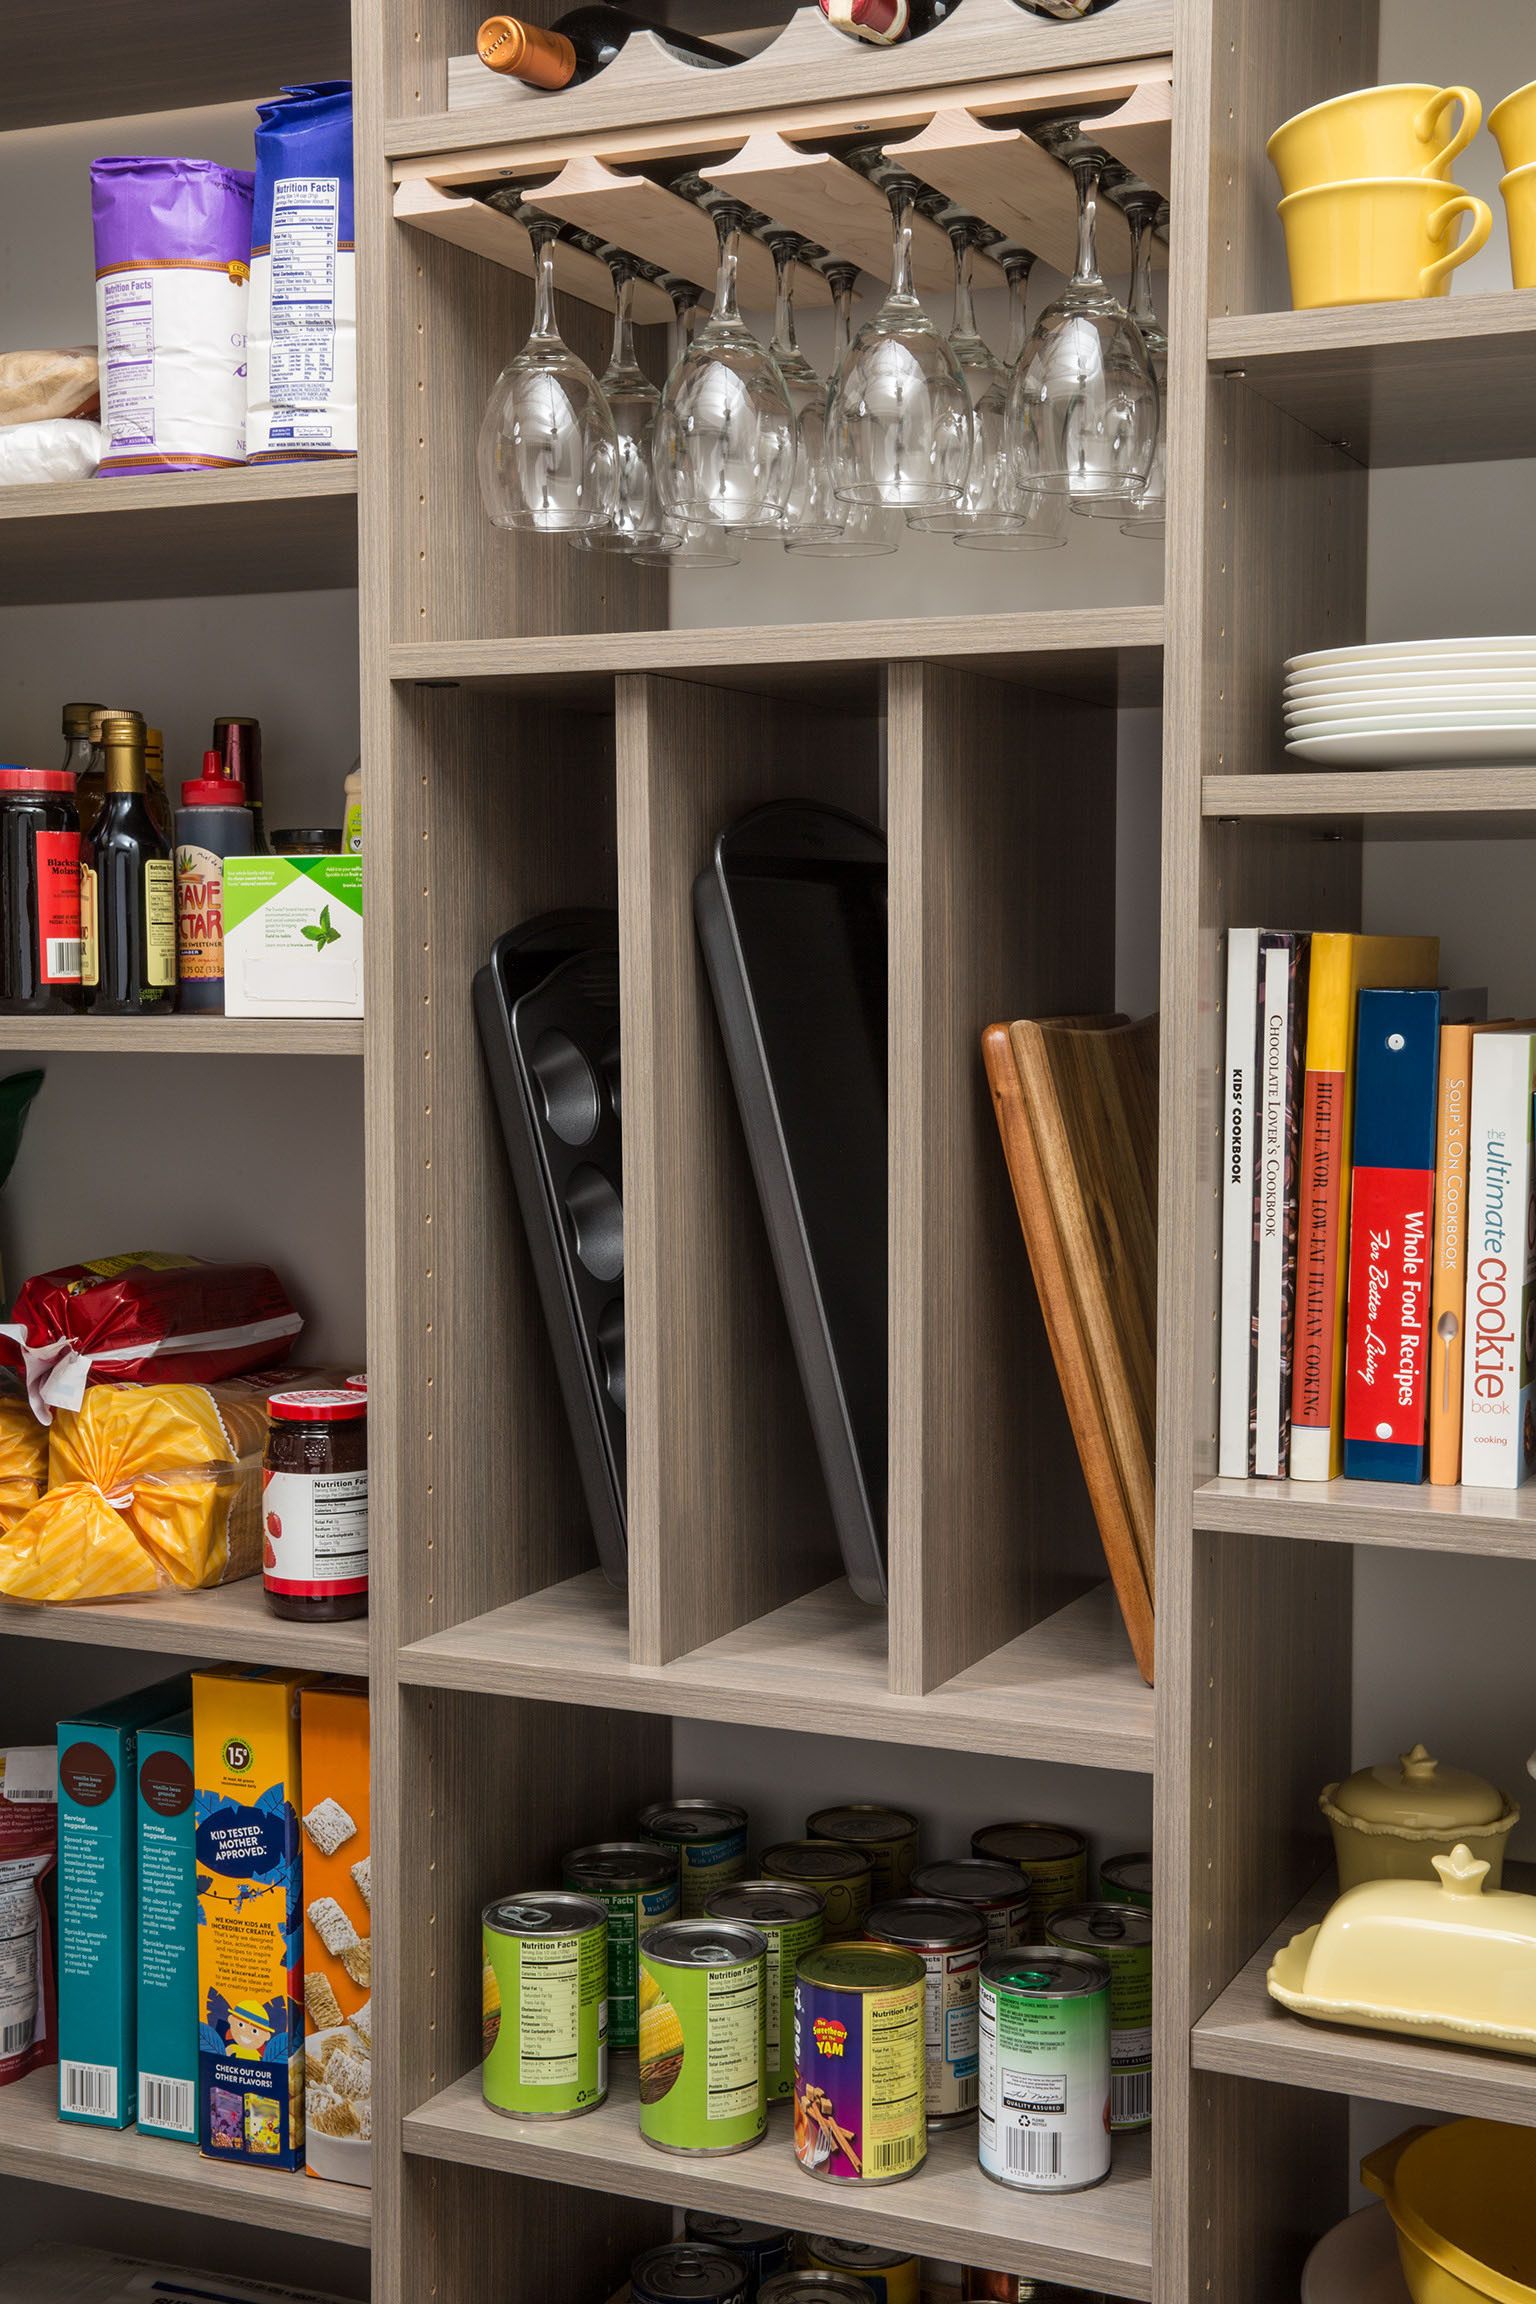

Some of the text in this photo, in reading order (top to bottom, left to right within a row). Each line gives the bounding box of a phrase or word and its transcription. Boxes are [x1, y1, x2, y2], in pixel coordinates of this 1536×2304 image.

[276, 183, 335, 194] Nutrition Facts
[106, 281, 152, 295] Nutrition Facts
[178, 881, 221, 910] GAVE
[179, 910, 223, 939] CTAR
[195, 965, 204, 973] OZ
[1231, 1068, 1242, 1184] KIDS' COOKBOOK
[1265, 1014, 1283, 1238] CHOCOLATE LOVER'S COOKBOOK
[1487, 1128, 1506, 1140] the
[1445, 1079, 1465, 1270] SOUP'S ON COOKBOOK
[1484, 1141, 1512, 1254] ultimate
[1309, 1199, 1327, 1265] LOW-FAT
[1306, 1271, 1324, 1338] ITALIAN
[1357, 1229, 1390, 1386] For Better Living
[1393, 1211, 1425, 1406] Whole Food Recipes
[1474, 1257, 1515, 1399] cookie
[1303, 1343, 1321, 1416] COOKING
[1471, 1399, 1510, 1415] book
[1474, 1434, 1508, 1446] cooking
[314, 1480, 352, 1488] Nutrition
[64, 1814, 85, 1823] Serving
[64, 1822, 98, 1831] suggestions
[143, 1823, 164, 1833] Serving
[210, 1826, 263, 1840] KID TESTED.
[64, 1836, 82, 1844] Spread
[143, 1832, 177, 1841] suggestions
[219, 1836, 258, 1850] MOTHER
[612, 1896, 634, 1904] Facts
[225, 1918, 243, 1926] KNOW
[64, 1928, 85, 1936] Sprinkle
[211, 1923, 276, 1937] INCREDIBLY CREATIVE.
[249, 1936, 273, 1944] designed
[521, 1940, 577, 1950] Nutrition Facts
[232, 1969, 270, 1978] kixcereal.com
[709, 1964, 758, 1980] Nutrition Facts
[228, 1984, 248, 1992] creating
[872, 2002, 918, 2018] Nutrition Facts
[813, 2026, 847, 2039] Sweetheart
[816, 2041, 843, 2056] YAM
[216, 2064, 238, 2075] CHECK
[255, 2070, 271, 2079] OUR
[215, 2072, 272, 2088] OTHER FLAVORS!
